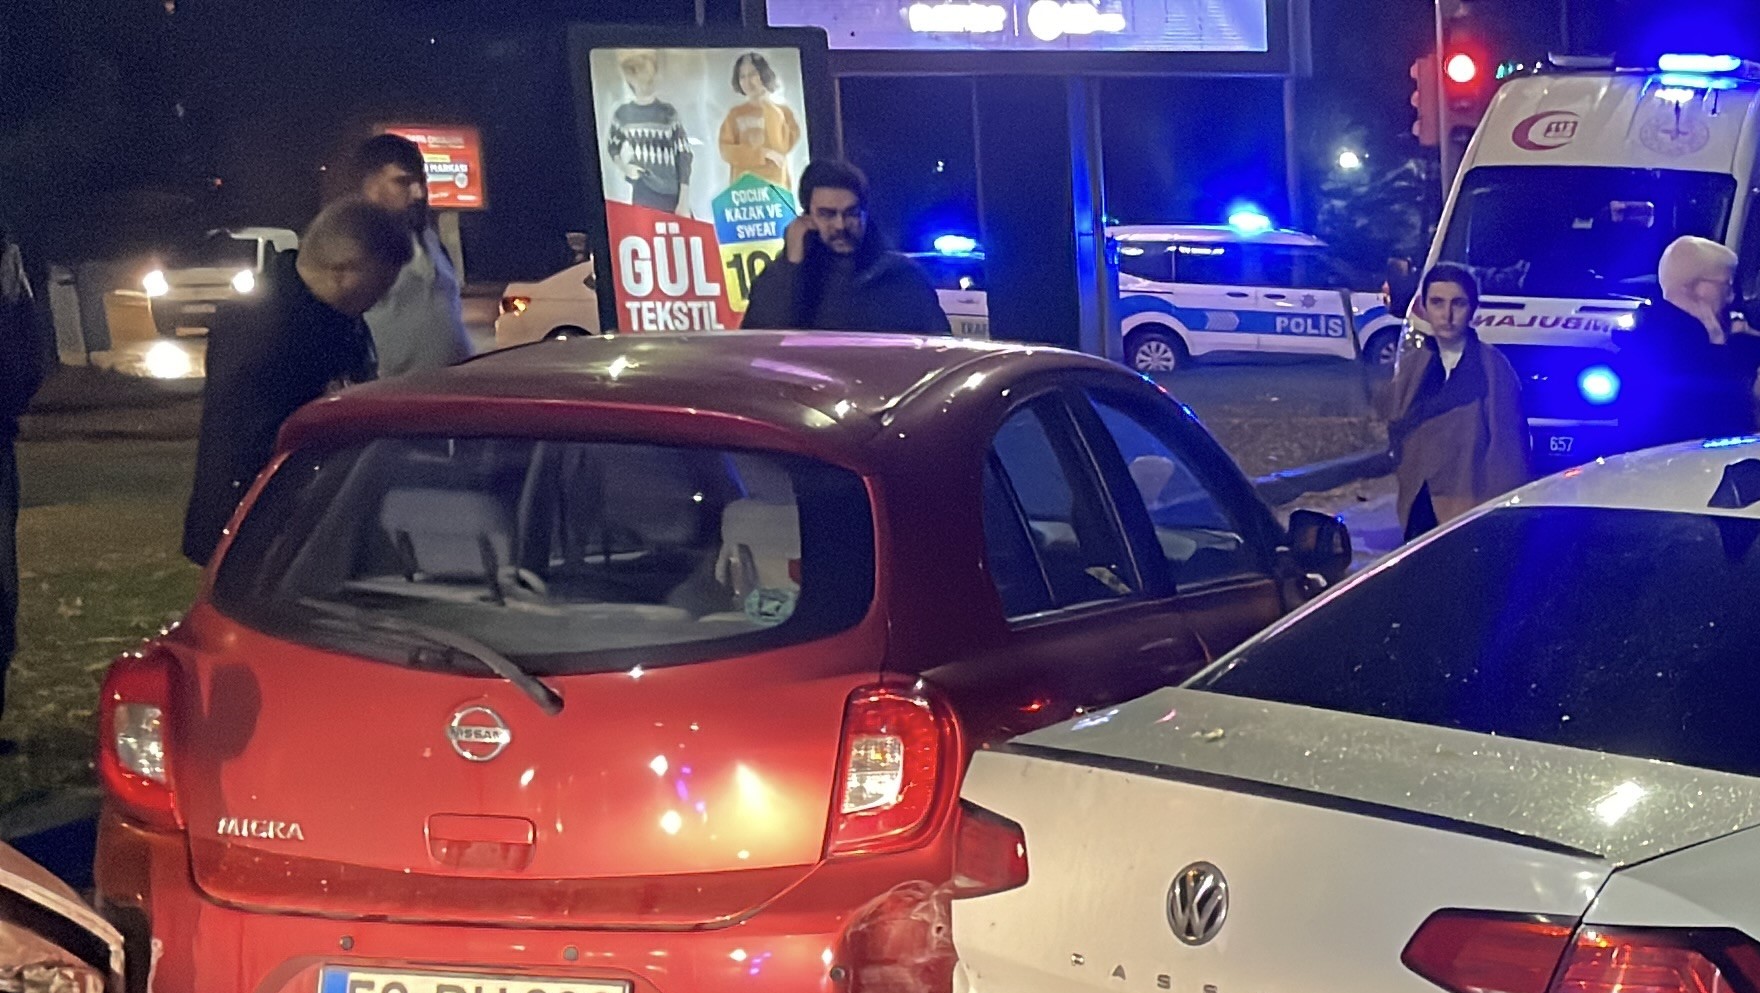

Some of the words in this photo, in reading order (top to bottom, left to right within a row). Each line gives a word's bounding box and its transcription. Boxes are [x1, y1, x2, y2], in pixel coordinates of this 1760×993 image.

[731, 187, 770, 206] ÇOCUK
[725, 206, 765, 223] KAZAK
[766, 203, 783, 219] VE
[736, 221, 776, 239] SWEAT
[619, 222, 720, 297] GÜL
[1276, 315, 1343, 337] POLİS
[1550, 436, 1574, 452] 657
[217, 817, 305, 841] MICRA
